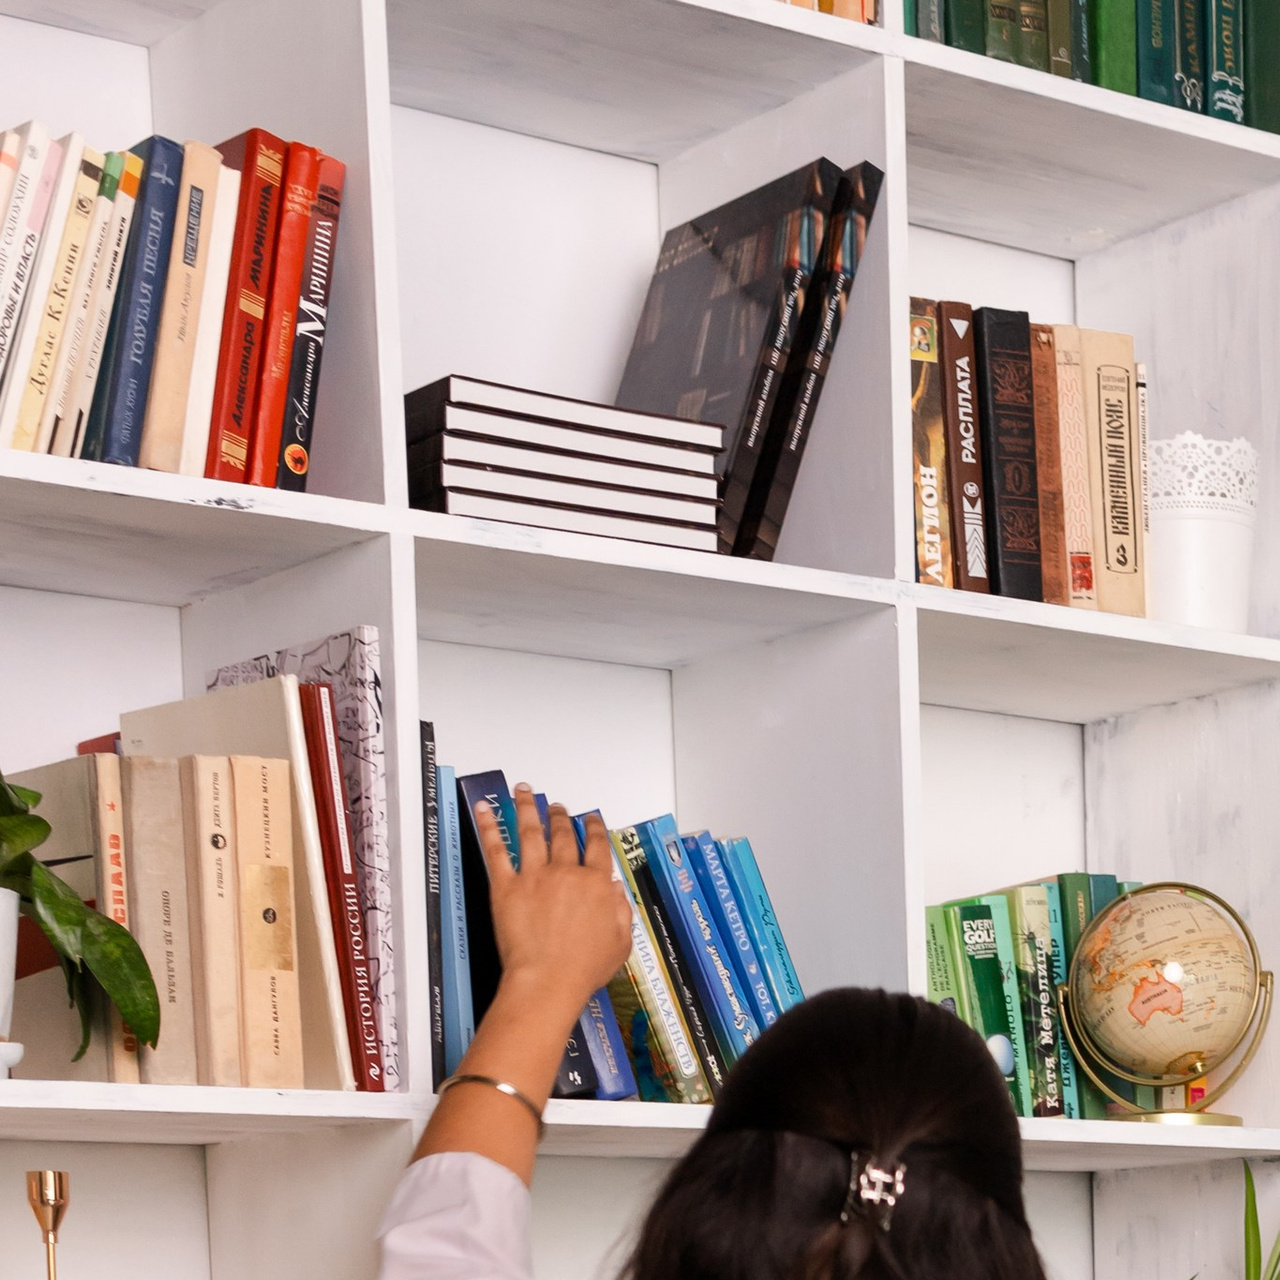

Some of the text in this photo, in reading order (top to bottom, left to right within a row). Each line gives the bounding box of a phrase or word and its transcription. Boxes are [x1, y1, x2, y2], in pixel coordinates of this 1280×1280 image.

[14, 232, 36, 282] ВЛАСТЬ
[183, 188, 203, 265] КРЕЩЕНИЕ
[10, 281, 21, 294] И
[131, 207, 162, 365] ГОЛУБАЯ ПЕСНЯ
[232, 181, 273, 427] Александра МАРИНИНА
[0, 295, 19, 358] ДОРОВЬЕ
[30, 328, 57, 395] Дуглас
[760, 368, 774, 399] альбом
[802, 372, 817, 403] альбом
[956, 356, 976, 462] РАСПЛАТА
[1104, 398, 1129, 535] КАМЕННЫЙ ПОЯС
[920, 464, 943, 582] ЛЕГИОН
[260, 764, 271, 859] КУЗНЕЦКИЙ МОСТ
[448, 800, 459, 850] ЖИВОТНЫХ
[426, 813, 440, 893] ПИТЕРСКИЕ
[452, 864, 464, 911] РАССКАЗЫ
[701, 842, 751, 952] МАРТА КЕТРО
[162, 890, 176, 1003] ОНОРЕ ДЕ БАЛЬЗАК
[344, 881, 378, 1056] ИСТОРИЯ РОССИИ
[458, 925, 466, 959] СКАЗКИ
[687, 897, 750, 1030] Сумасшедший король
[925, 938, 940, 992] ANTHOLOGIE
[937, 943, 952, 990] FRANÇAISE
[270, 975, 279, 1022] ДАНГУЛОВ
[628, 920, 693, 1071] КНИГА БЛАЖЕНСТВ
[1003, 993, 1019, 1058] MANOLO
[1033, 935, 1058, 1109] Катя Метелица
